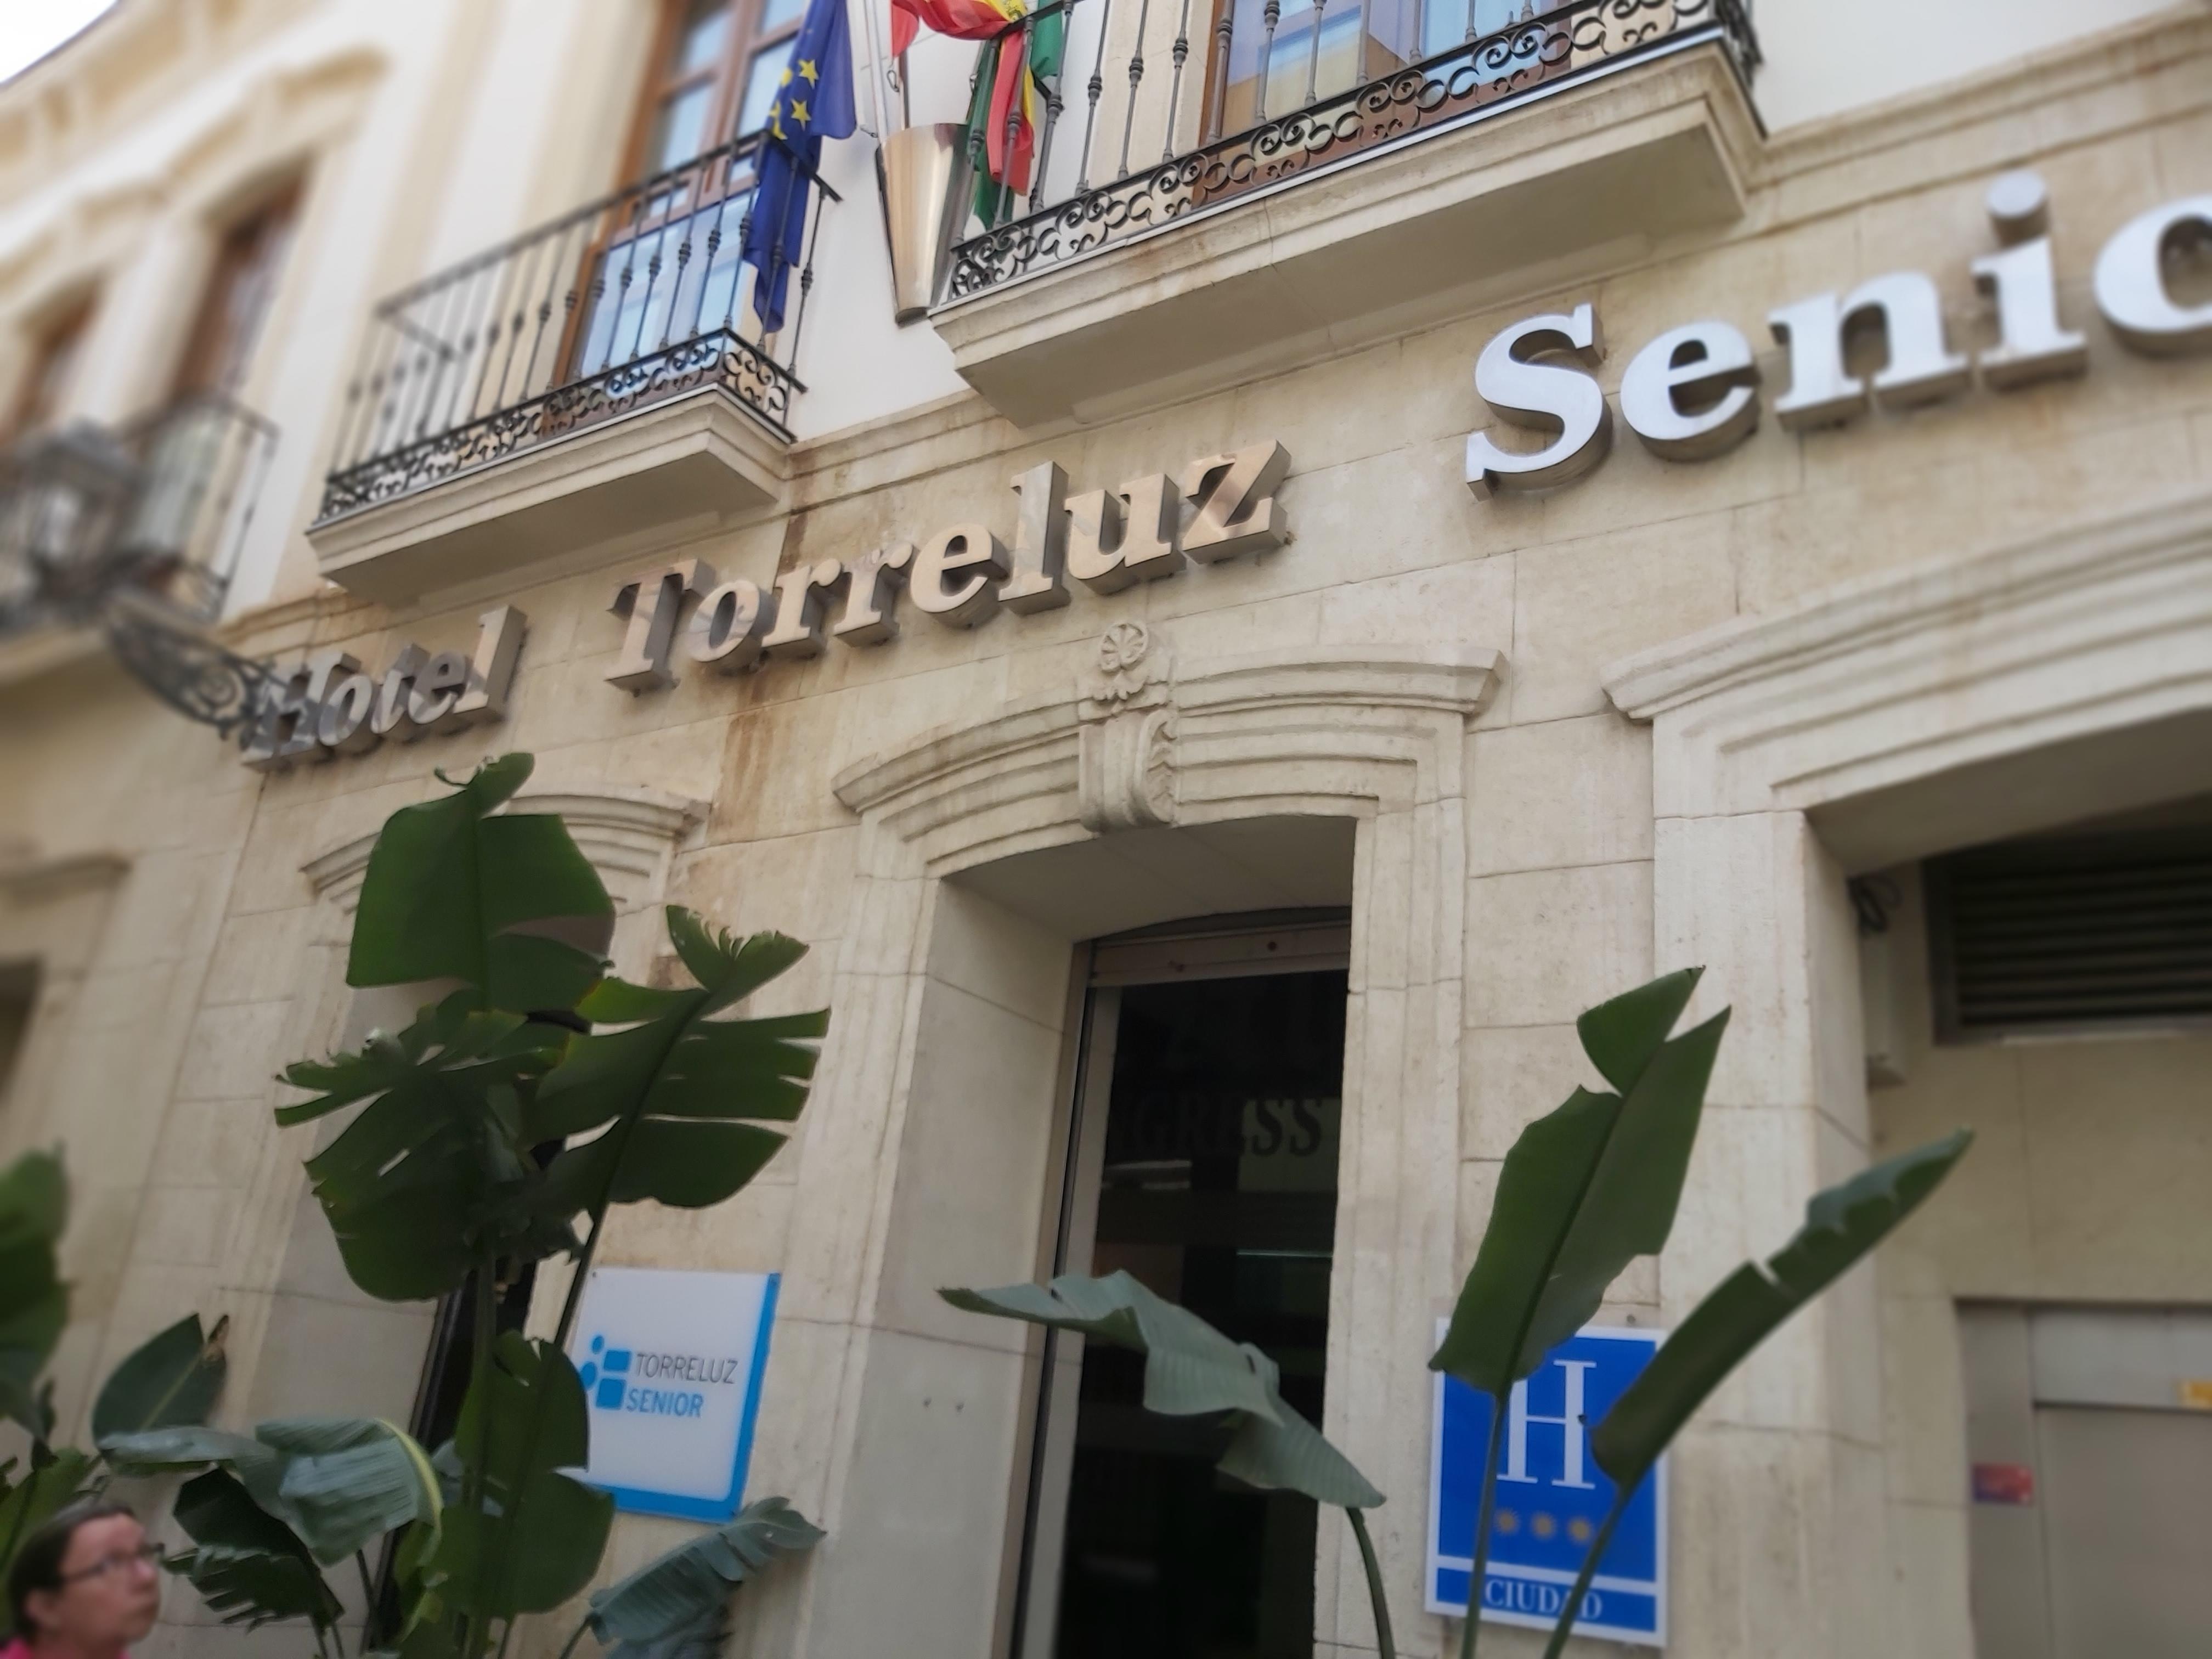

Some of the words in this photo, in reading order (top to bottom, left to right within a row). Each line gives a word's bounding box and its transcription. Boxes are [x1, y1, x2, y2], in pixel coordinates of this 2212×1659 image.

[240, 605, 524, 766] Hotel
[606, 439, 1286, 686] Torreluz
[627, 1388, 704, 1417] SENIOR
[636, 1352, 738, 1384] TORRELUZ
[1496, 1359, 1597, 1489] H
